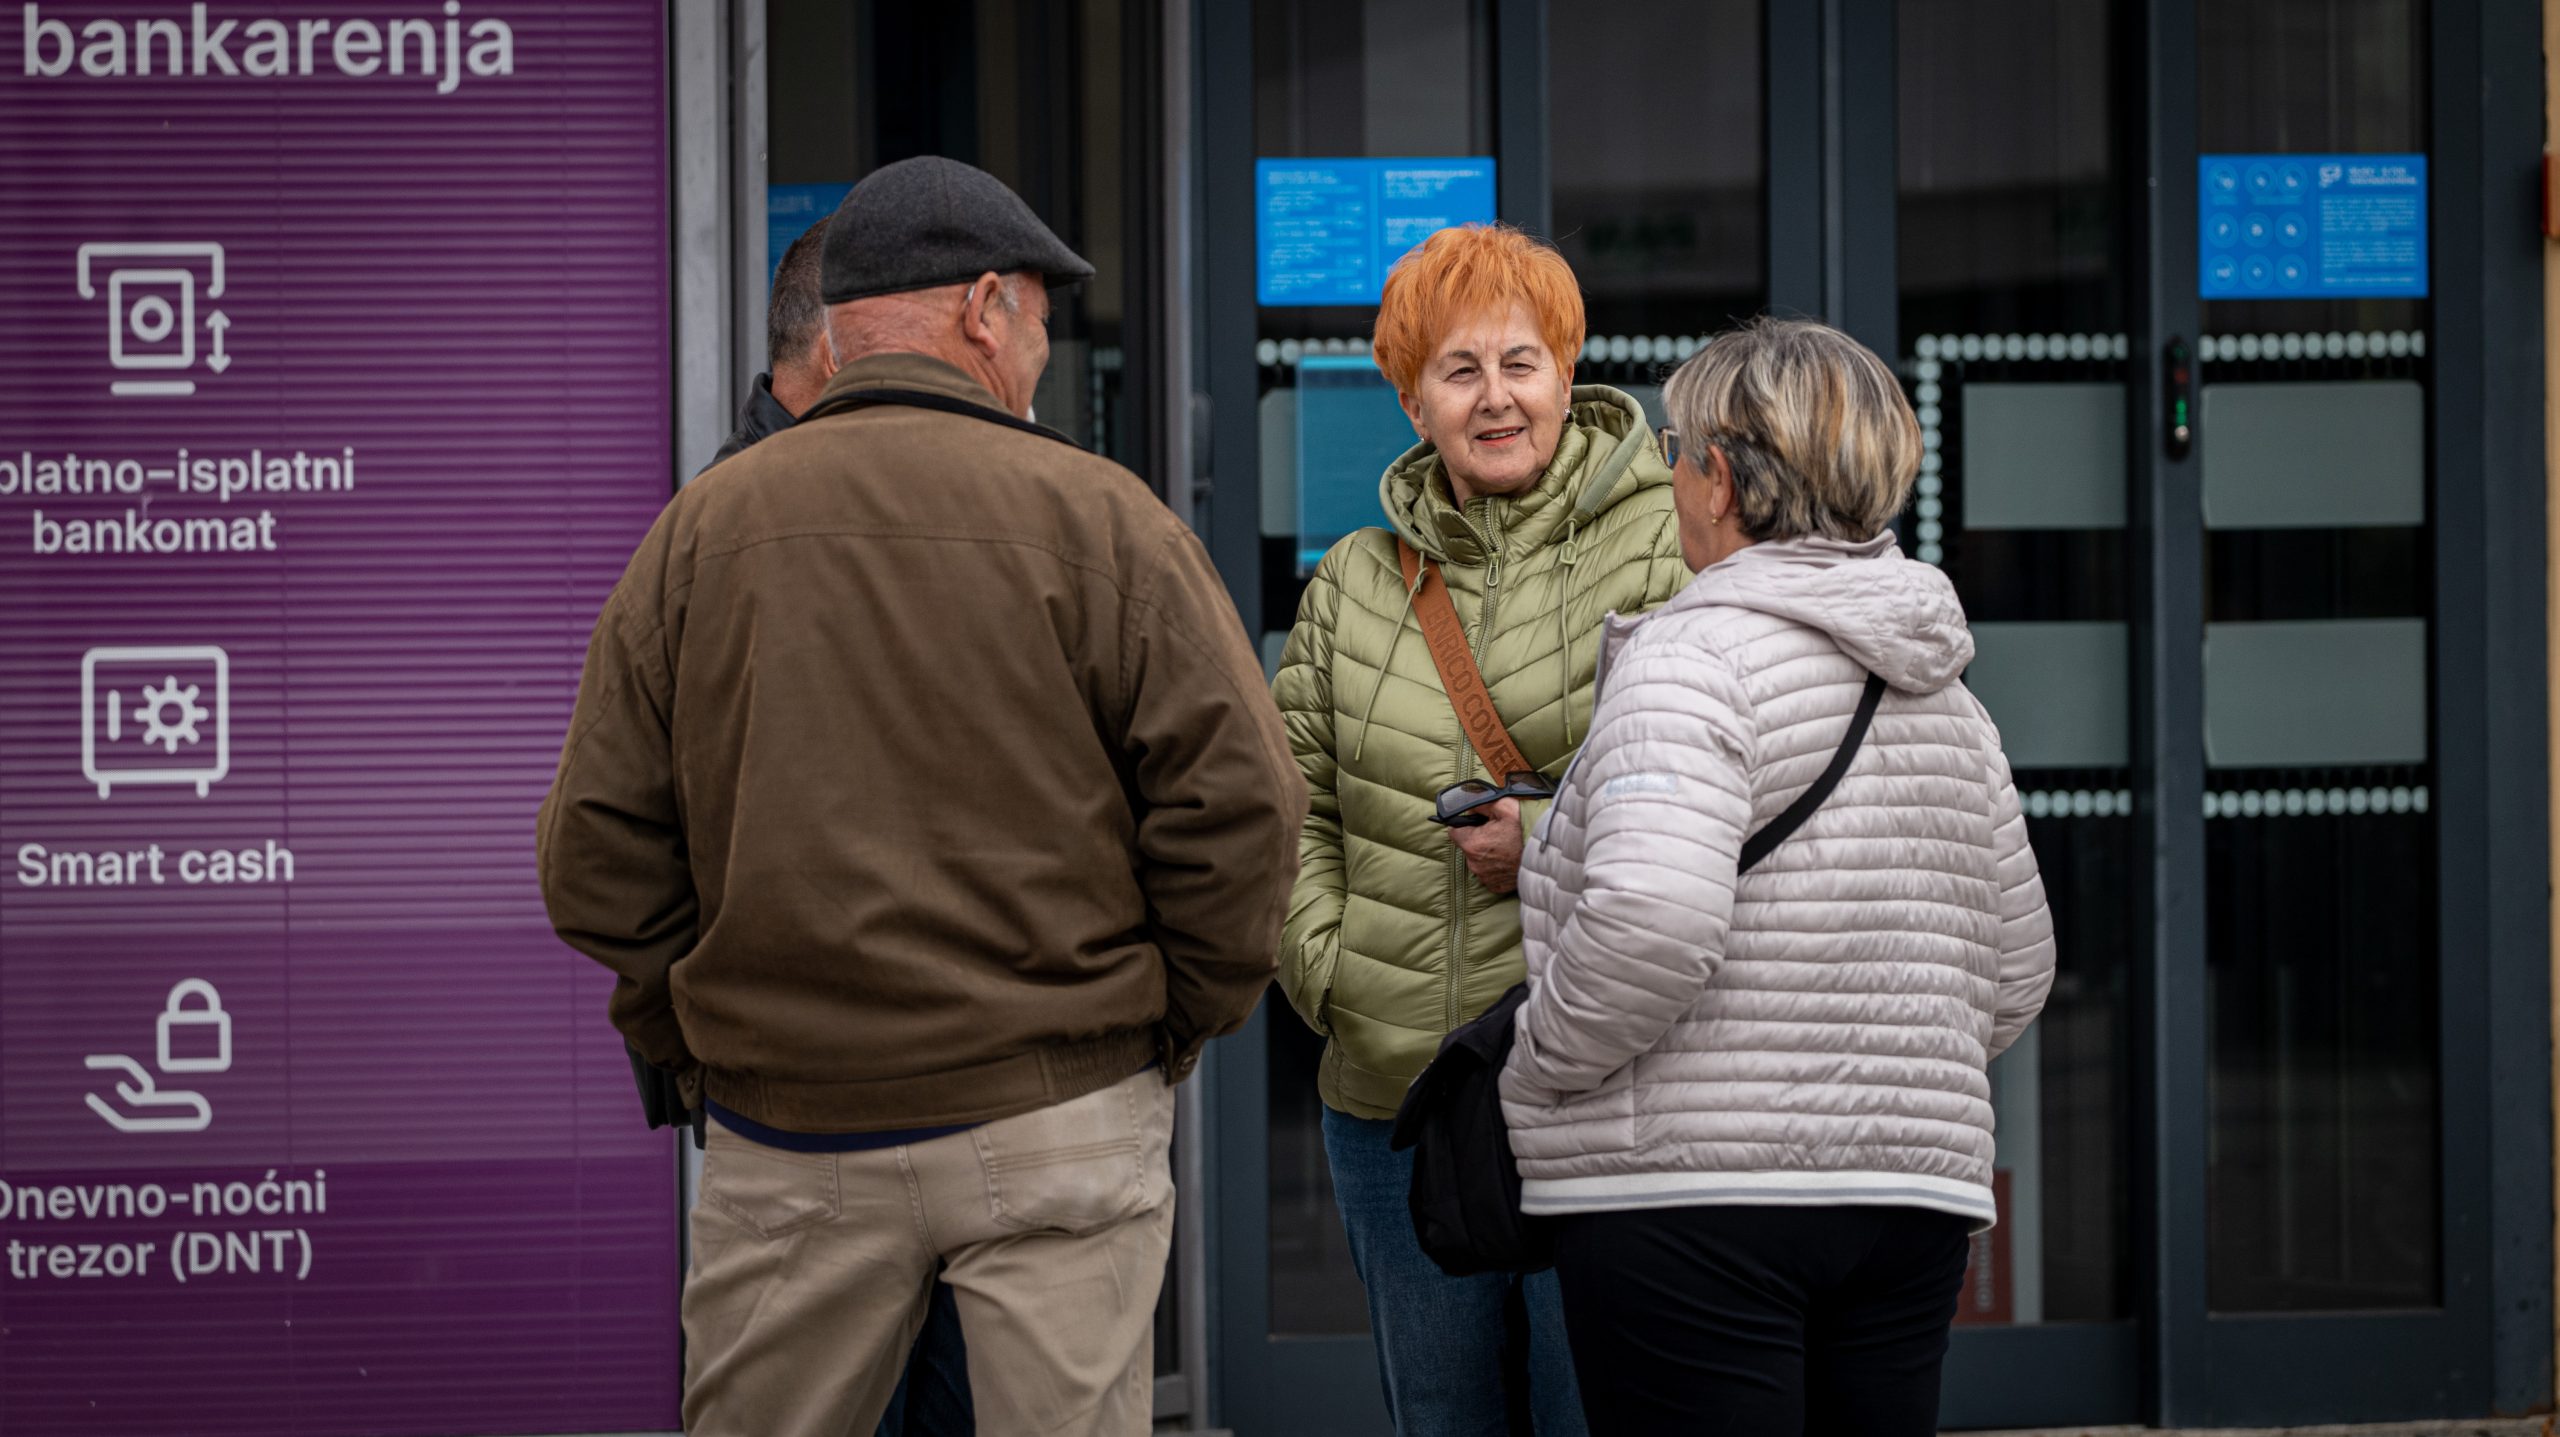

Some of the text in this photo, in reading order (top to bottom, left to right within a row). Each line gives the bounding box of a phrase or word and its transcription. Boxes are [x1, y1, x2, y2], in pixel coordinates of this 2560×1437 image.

[24, 1, 513, 94] bankarenja
[33, 509, 277, 553] bankomat
[1426, 605, 1475, 694] ENRICO
[17, 839, 295, 886] Smart cash
[7, 1229, 312, 1282] trezor (DNT)
